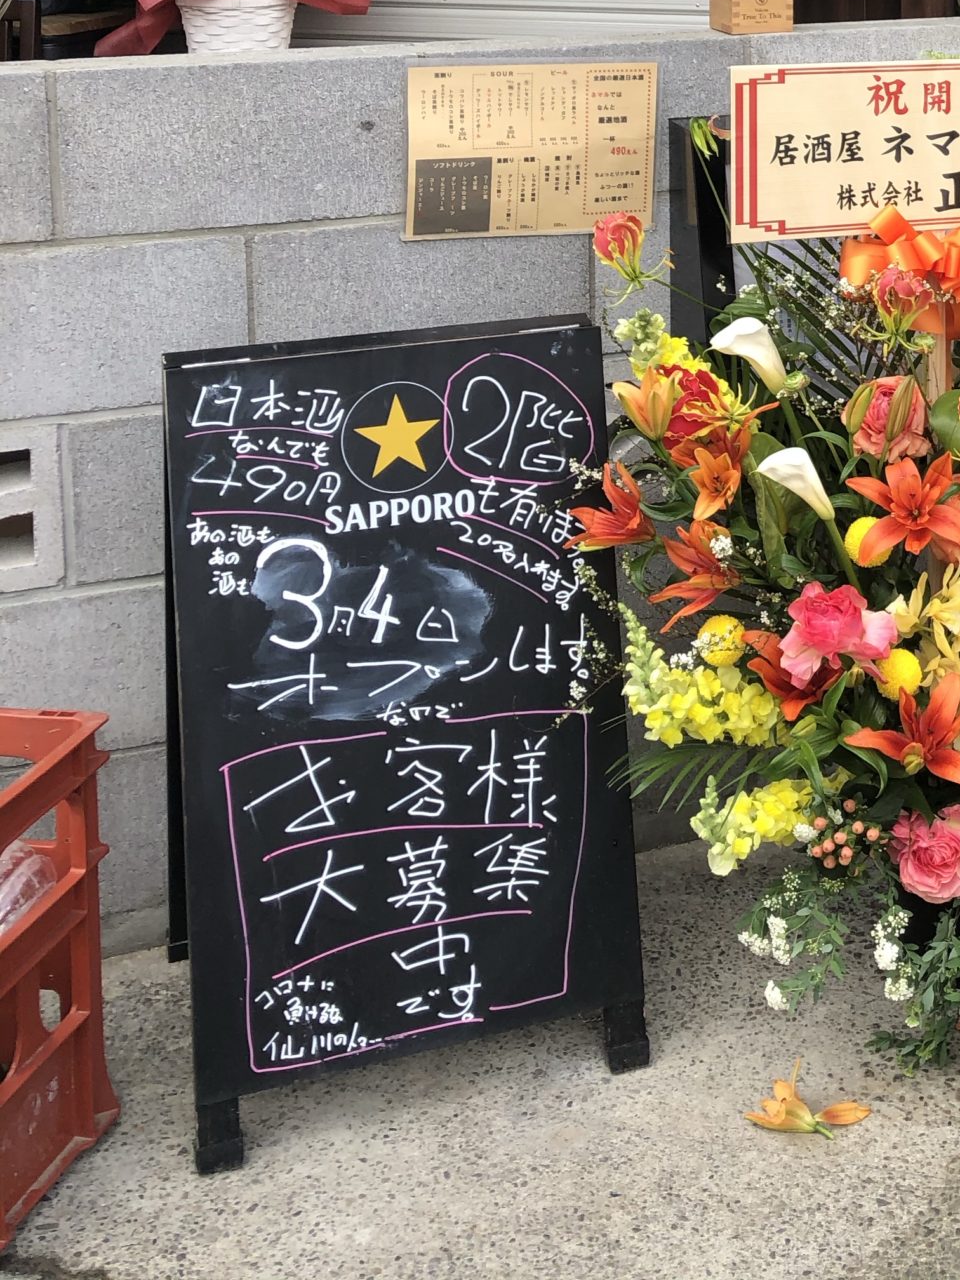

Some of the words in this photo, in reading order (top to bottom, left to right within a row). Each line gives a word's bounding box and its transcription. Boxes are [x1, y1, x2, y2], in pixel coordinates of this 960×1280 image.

[432, 161, 476, 169] ソフトドリンク
[191, 379, 345, 433] 日本酒
[463, 375, 586, 474] 2階
[229, 430, 330, 467] なんでも
[191, 456, 341, 506] 490円
[186, 517, 275, 547] あの酒も
[324, 488, 476, 535] SAPPORO
[208, 546, 241, 566] あの
[208, 570, 250, 596] 酒も
[257, 537, 460, 650] 3月4日
[376, 701, 463, 726] なので
[243, 729, 558, 833] お客様
[259, 834, 550, 945] 大募集
[391, 925, 470, 974] 中
[254, 975, 335, 1010] コロナに
[283, 996, 344, 1025] 負けるな
